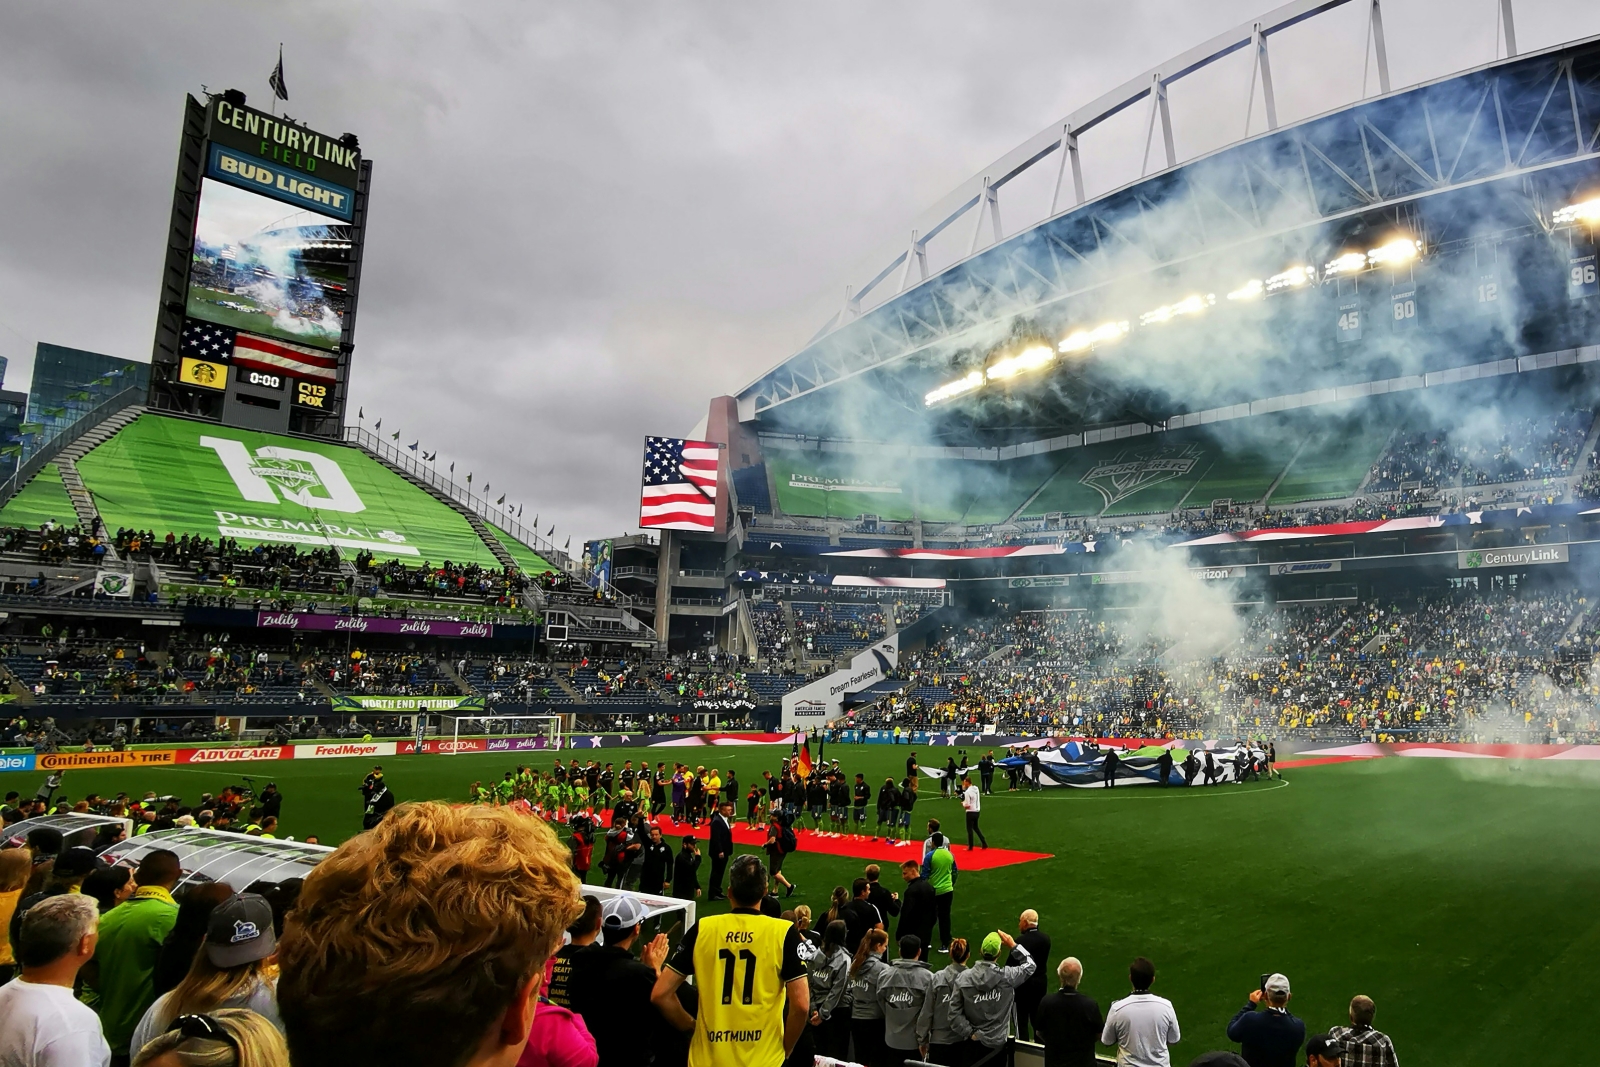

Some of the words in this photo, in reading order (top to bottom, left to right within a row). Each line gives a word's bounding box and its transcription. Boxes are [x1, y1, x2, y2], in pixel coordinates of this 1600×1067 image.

[217, 100, 358, 171] CENTURYLINK
[260, 141, 316, 172] FIELD
[220, 155, 273, 185] BUD
[276, 174, 344, 208] LIGHT
[1571, 265, 1596, 286] 96
[1478, 283, 1498, 303] 12
[1394, 300, 1415, 320] 80
[1338, 311, 1359, 330] 45
[250, 372, 279, 388] 0:00
[298, 382, 326, 396] Q13
[298, 393, 324, 407] FOX
[213, 510, 366, 538] PREMERA
[226, 529, 262, 537] BLUE
[267, 533, 312, 542] CROSS
[1485, 549, 1559, 563] CenturyLink
[1191, 568, 1228, 579] verizon
[830, 681, 850, 696] Dream
[850, 667, 878, 686] Fearlessly
[361, 699, 394, 708] NORTH
[396, 699, 415, 709] END
[417, 699, 458, 709] FAITHFUL
[41, 752, 125, 769] Continental
[141, 753, 171, 762] TIRE
[191, 748, 281, 761] ADVOCARE
[725, 931, 754, 943] REUS
[718, 947, 757, 1006] 11
